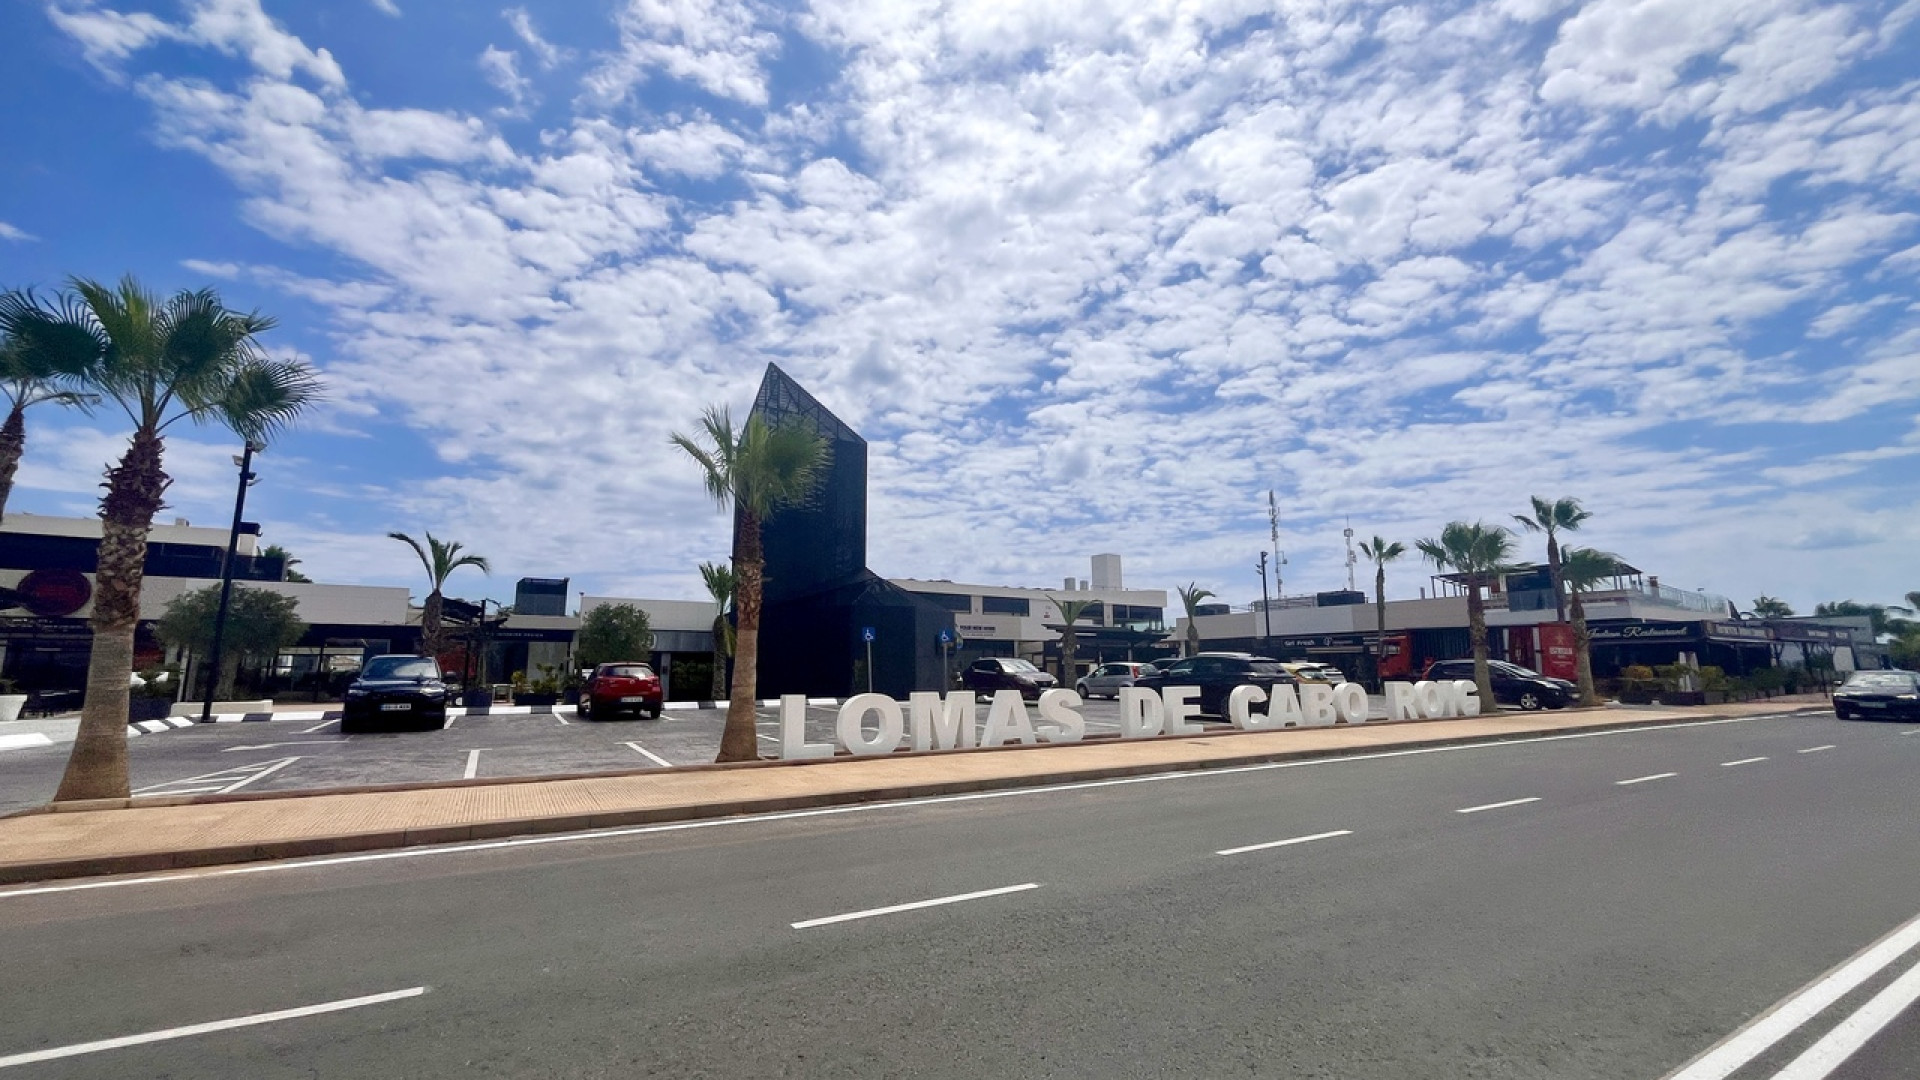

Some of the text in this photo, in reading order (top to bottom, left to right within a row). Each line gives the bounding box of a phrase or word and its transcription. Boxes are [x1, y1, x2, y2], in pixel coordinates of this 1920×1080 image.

[1623, 626, 1688, 638] Restaurant
[779, 680, 1480, 760] LOMAS DE CABO ROIG
